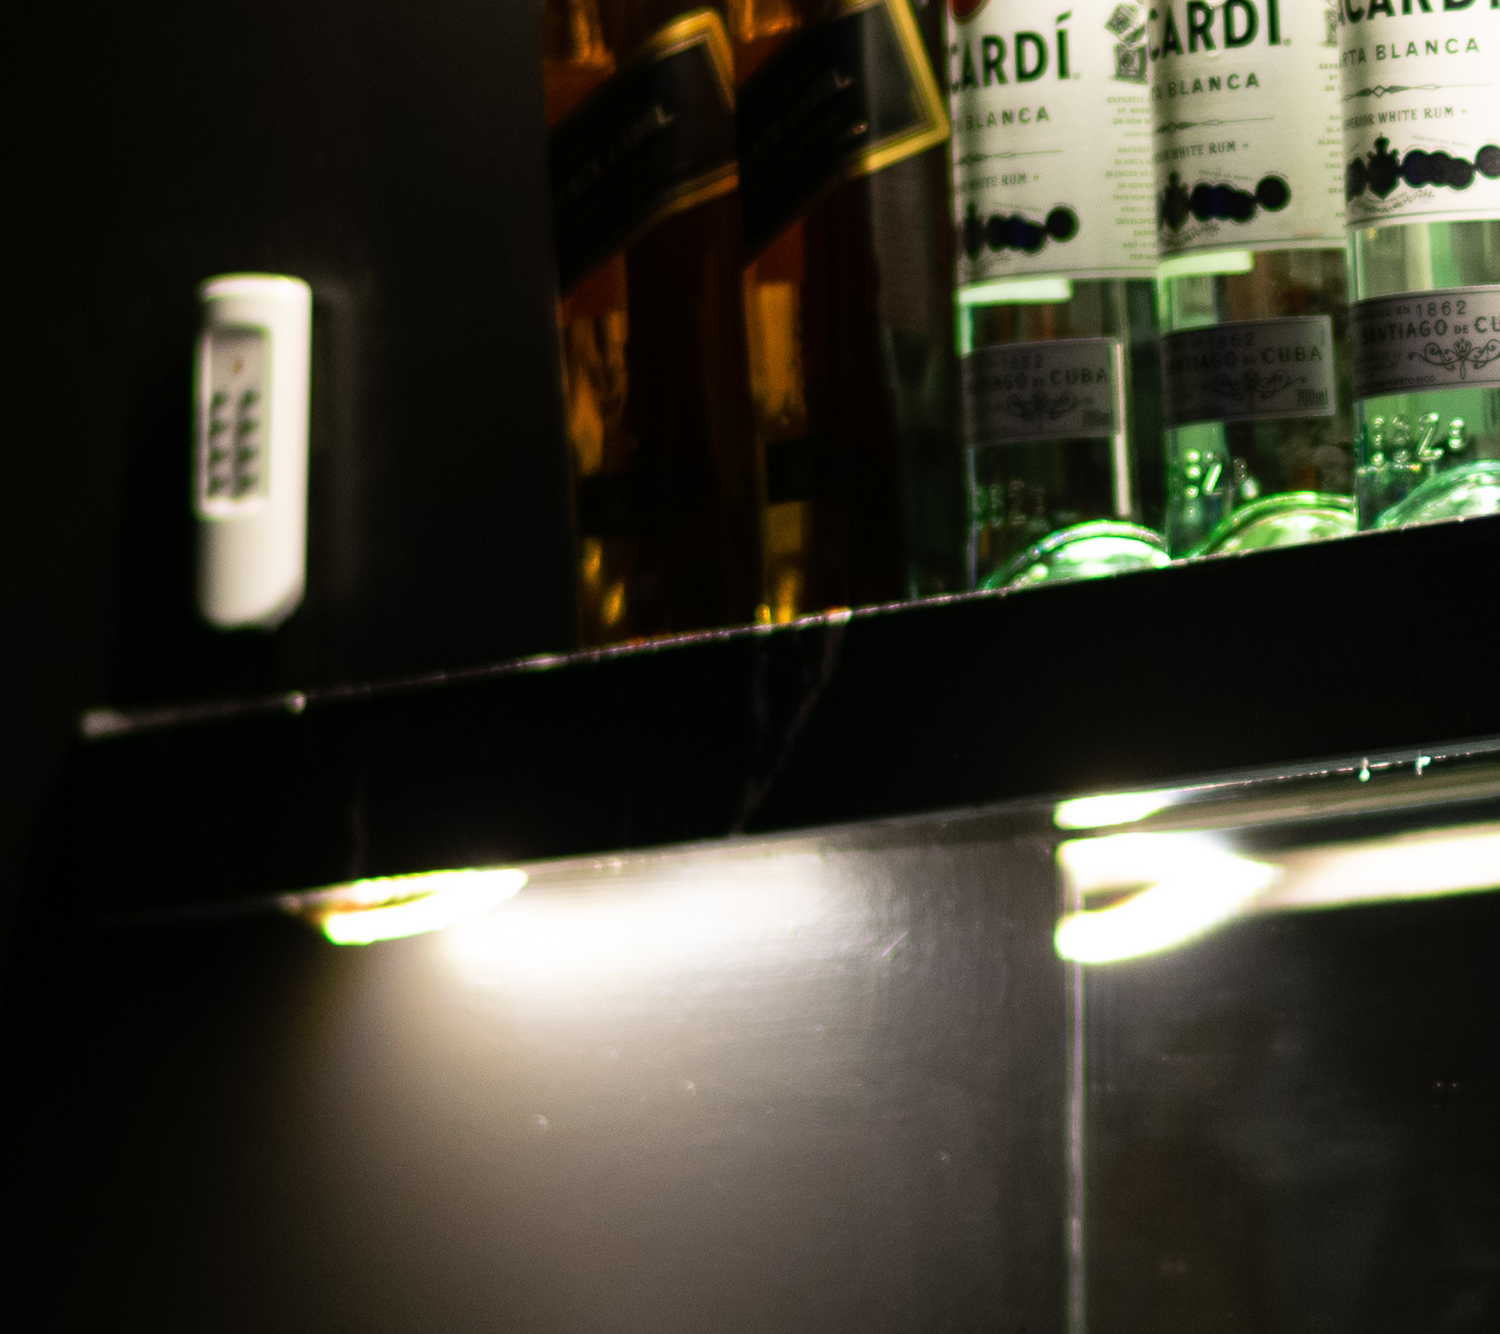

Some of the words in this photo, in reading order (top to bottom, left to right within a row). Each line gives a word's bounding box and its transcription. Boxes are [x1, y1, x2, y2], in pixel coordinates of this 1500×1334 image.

[1375, 37, 1480, 62] BLANCA
[1168, 71, 1260, 98] BLANCA
[1378, 108, 1418, 125] WHITE
[1415, 300, 1468, 318] 1862
[1261, 345, 1323, 364] CUBA
